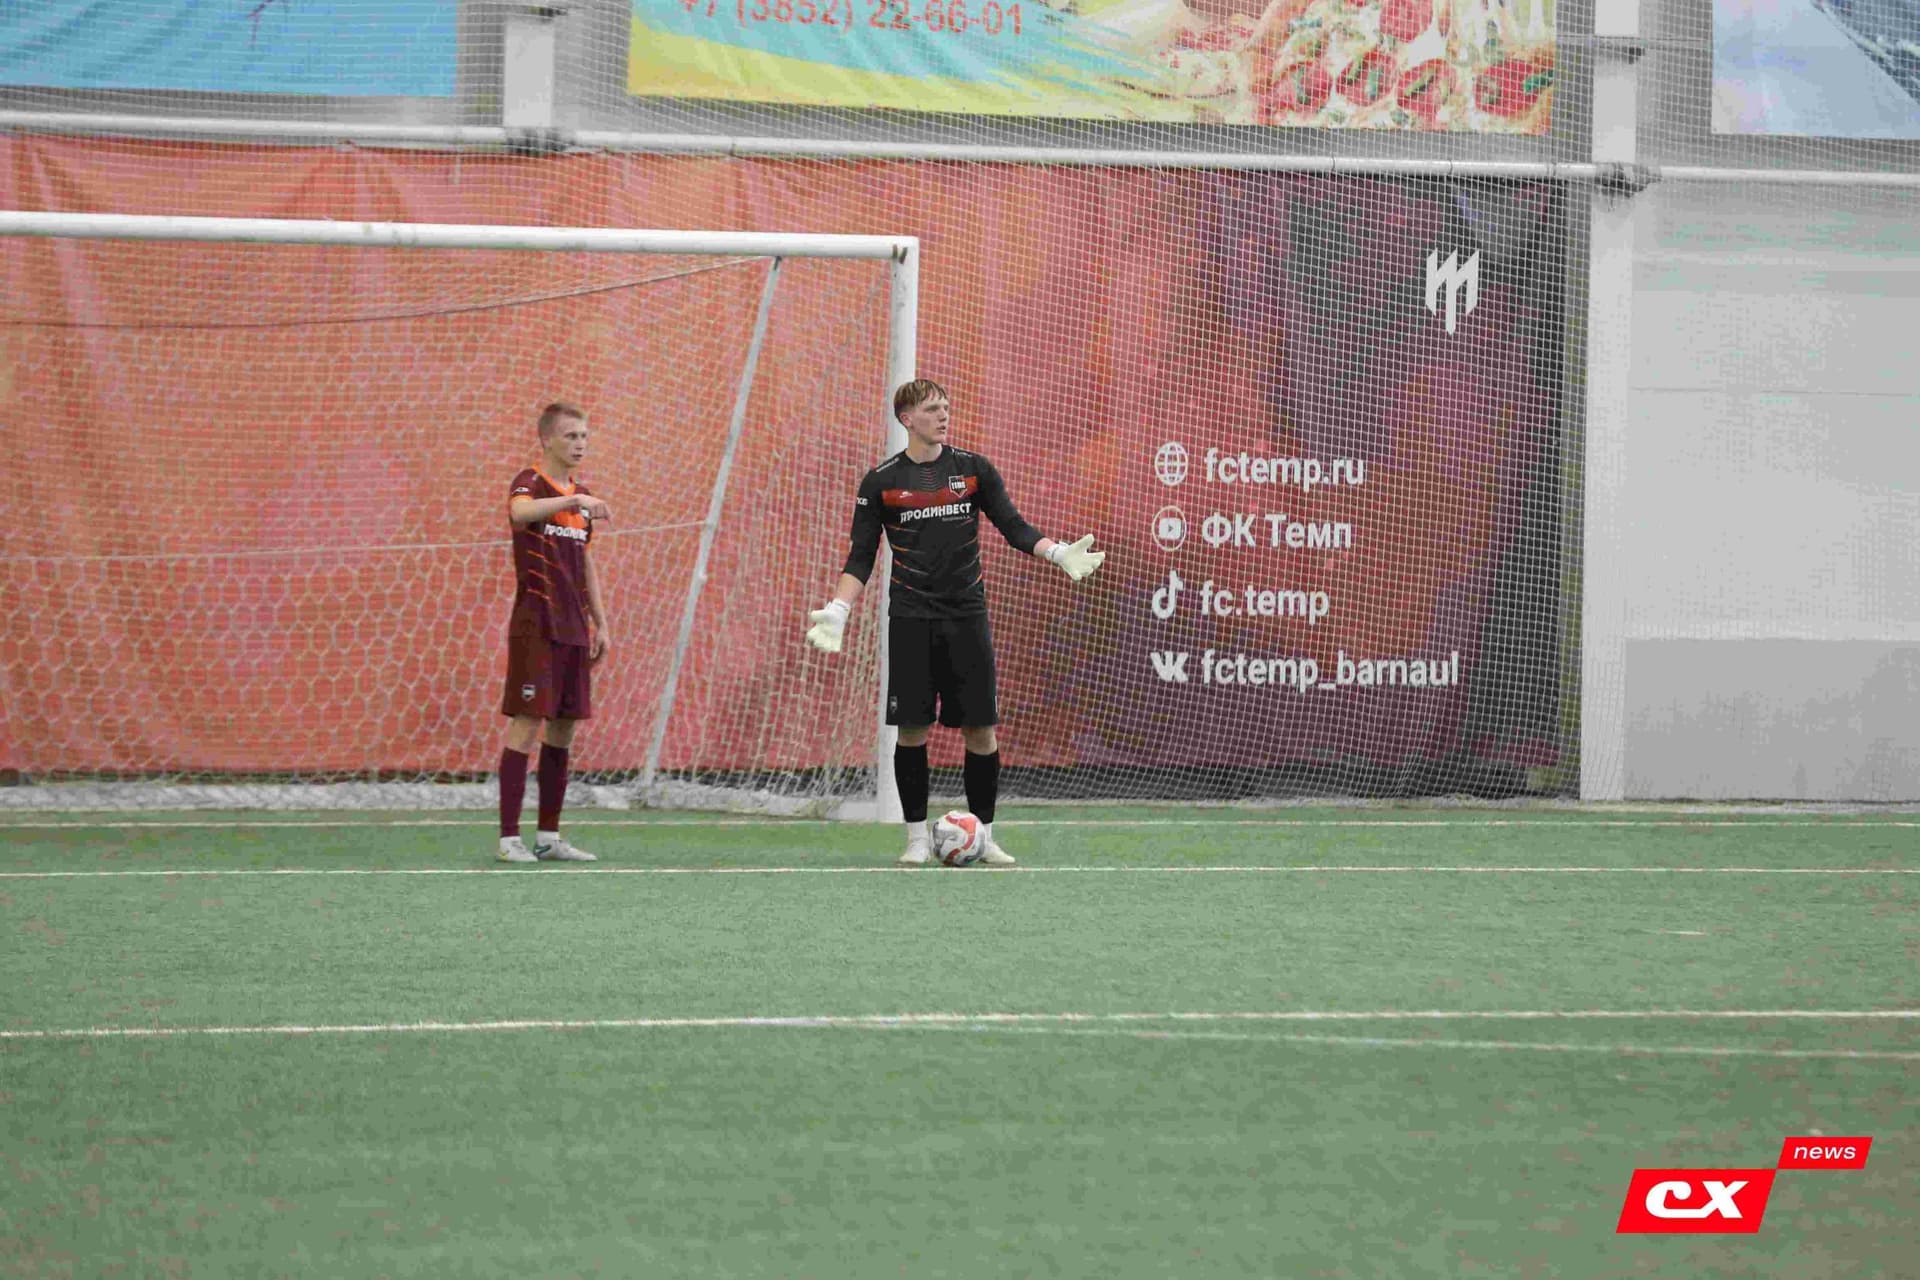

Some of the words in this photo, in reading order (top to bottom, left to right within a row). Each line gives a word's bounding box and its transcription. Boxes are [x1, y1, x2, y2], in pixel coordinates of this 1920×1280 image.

[868, 0, 1021, 35] 22-66-01
[1204, 447, 1365, 492] fctemp.ru
[900, 502, 972, 524] ПРОДИНВЕСТ
[1201, 511, 1256, 548] ФК
[1265, 514, 1352, 548] Темп
[1200, 580, 1330, 625] fc.temp
[1201, 649, 1459, 693] fctemp_barnaul
